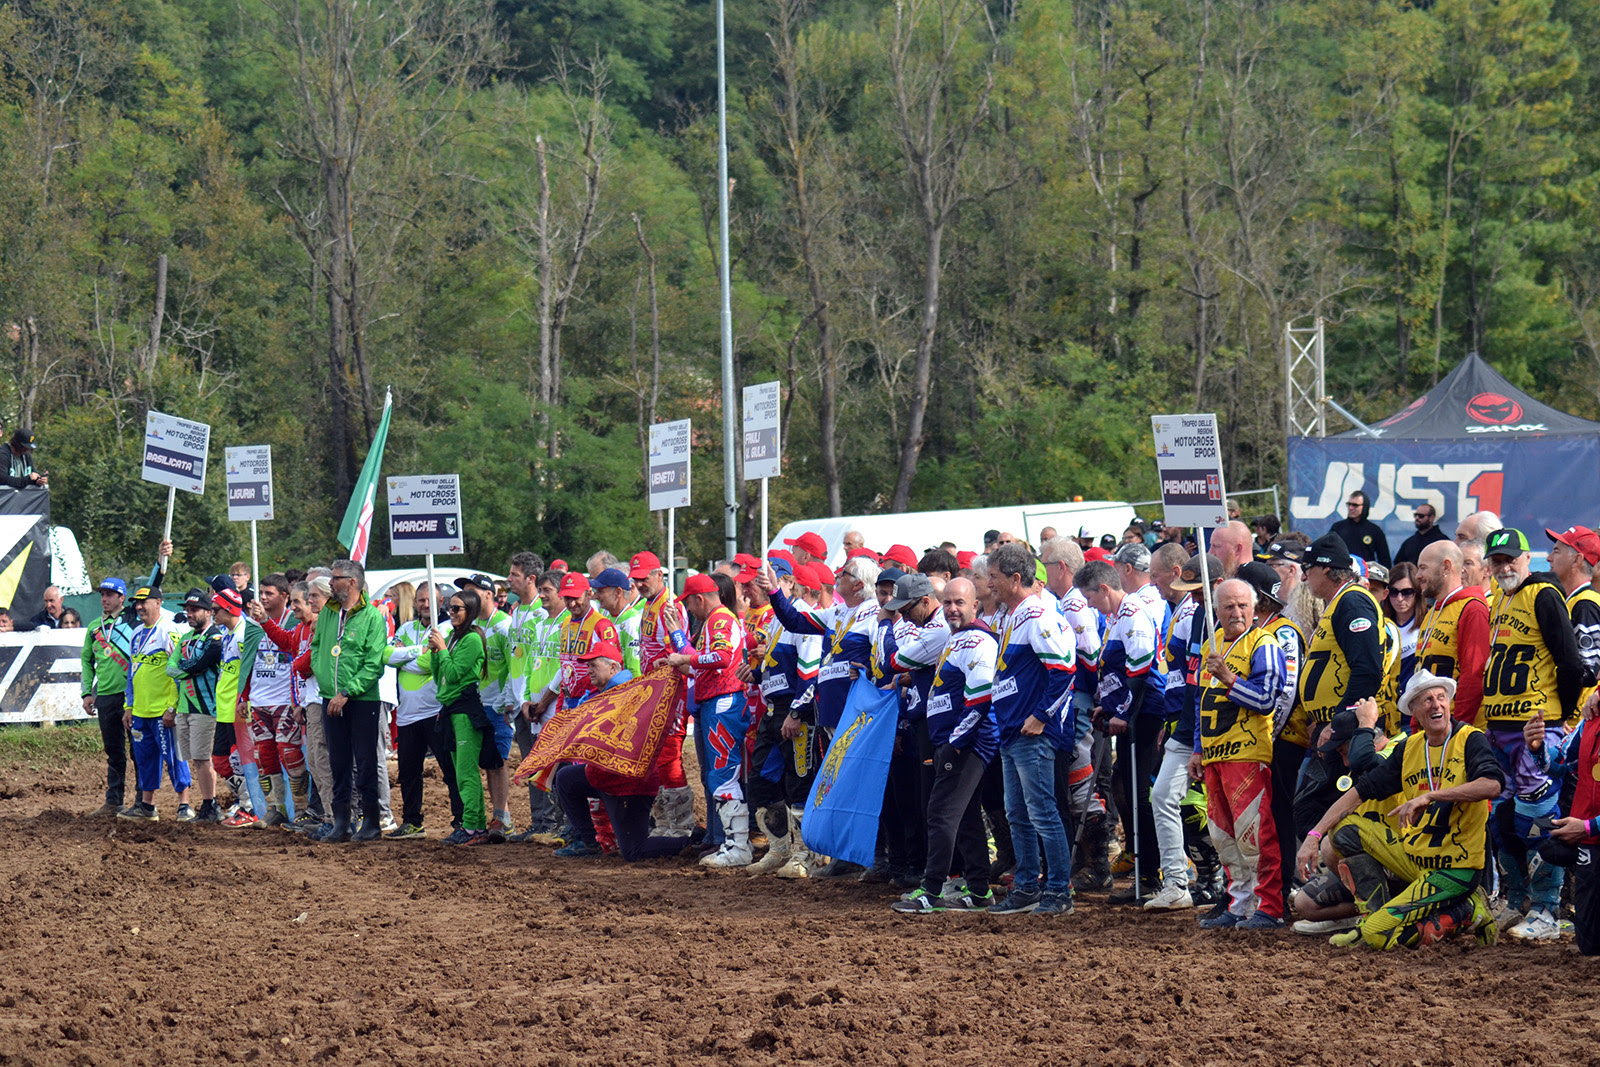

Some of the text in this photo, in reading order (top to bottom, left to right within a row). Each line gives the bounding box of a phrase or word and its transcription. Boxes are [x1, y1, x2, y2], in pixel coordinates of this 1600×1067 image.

[165, 429, 206, 444] MOTOCROSS
[661, 436, 687, 447] MOTOCROSS
[745, 432, 760, 444] FRIULI
[1174, 436, 1214, 447] MOTOCROSS
[183, 441, 205, 451] EPOCA
[673, 445, 687, 454] EPOCA
[750, 446, 766, 458] GIULIA
[1194, 448, 1216, 458] EPOCA
[146, 452, 192, 471] BASILICATA
[652, 470, 675, 486] VENETO
[1164, 480, 1206, 495] PIEMONTE
[230, 488, 255, 500] LIGURIA
[410, 490, 456, 498] MOTOCROSS
[393, 520, 438, 532] MARCHE
[1508, 616, 1530, 635] 2024
[1432, 628, 1450, 645] 2024
